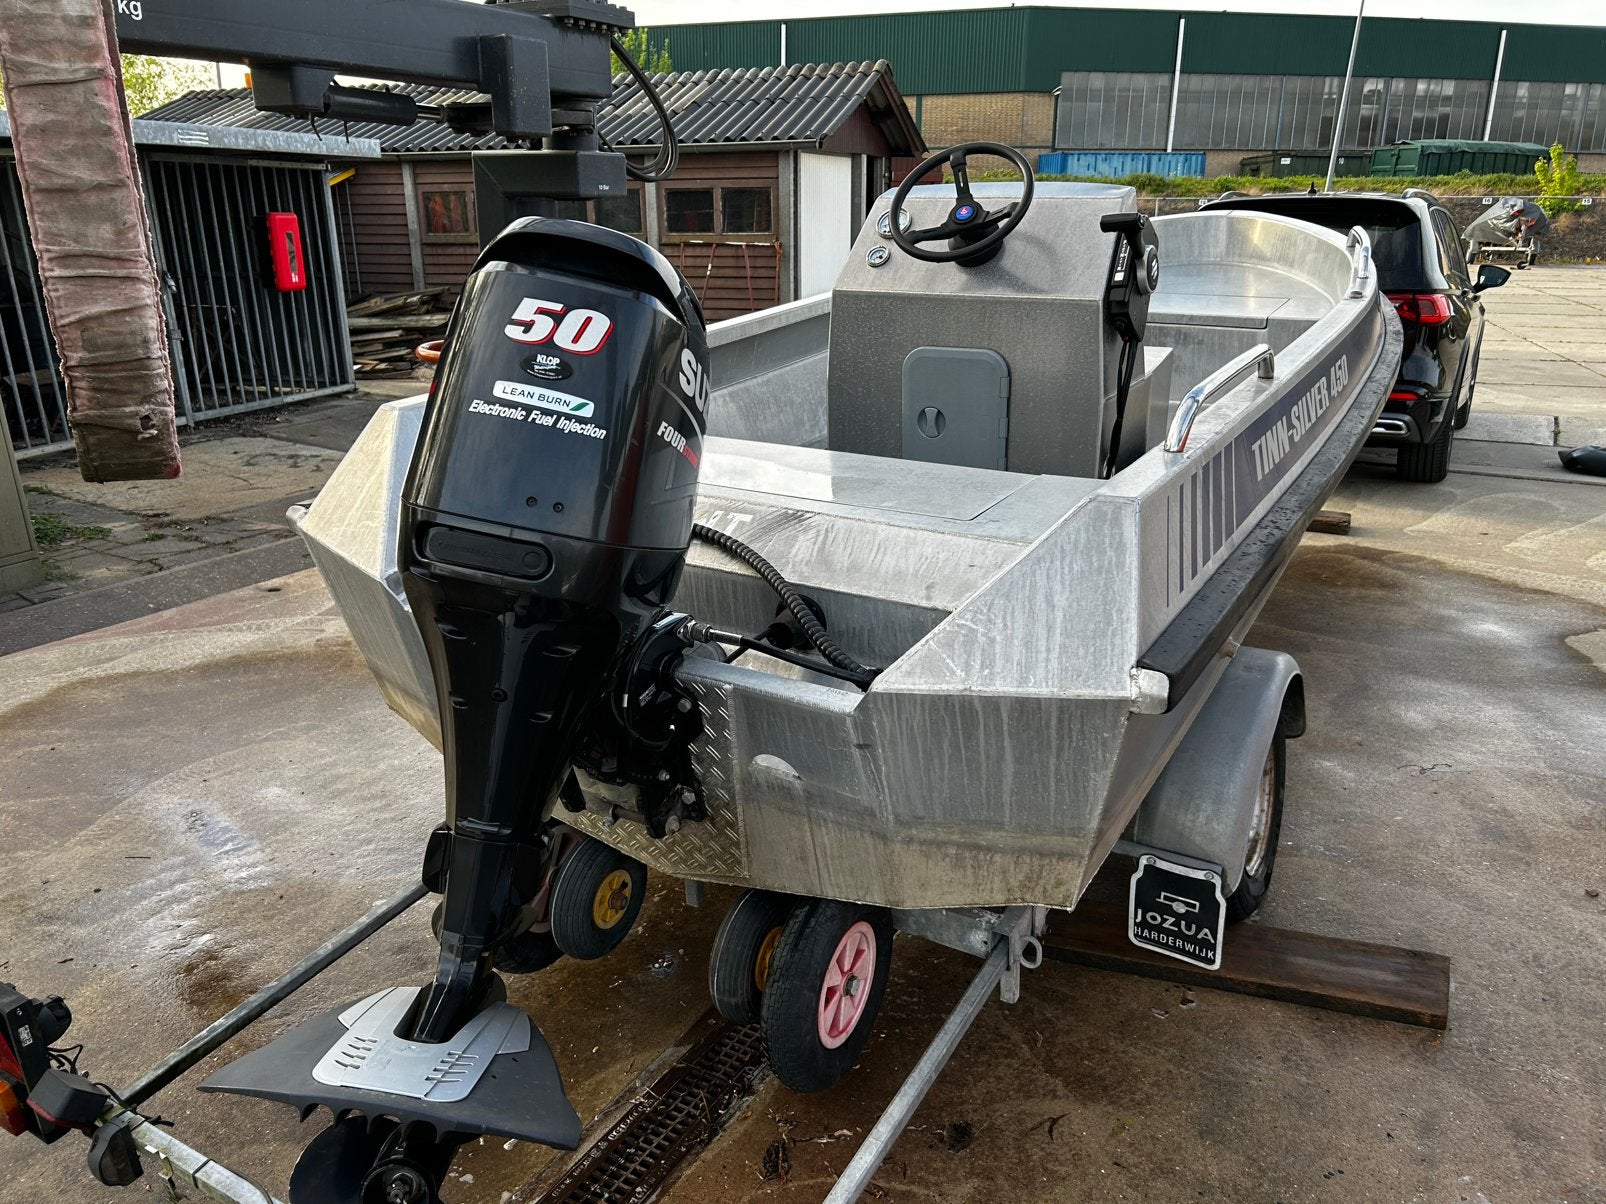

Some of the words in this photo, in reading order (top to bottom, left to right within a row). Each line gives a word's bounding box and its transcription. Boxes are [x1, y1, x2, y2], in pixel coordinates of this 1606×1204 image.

[117, 0, 143, 20] kg
[504, 297, 615, 355] 50
[536, 354, 561, 366] KLOP
[502, 387, 535, 399] LEAN
[537, 394, 571, 408] BURN
[468, 399, 526, 420] Electronic
[527, 410, 557, 427] Fuel
[556, 416, 607, 440] Injection
[1251, 376, 1330, 482] TINN-SILVER
[1330, 354, 1349, 398] 450
[1134, 926, 1215, 960] HARDERWIJK
[1135, 908, 1215, 944] JOZUA
